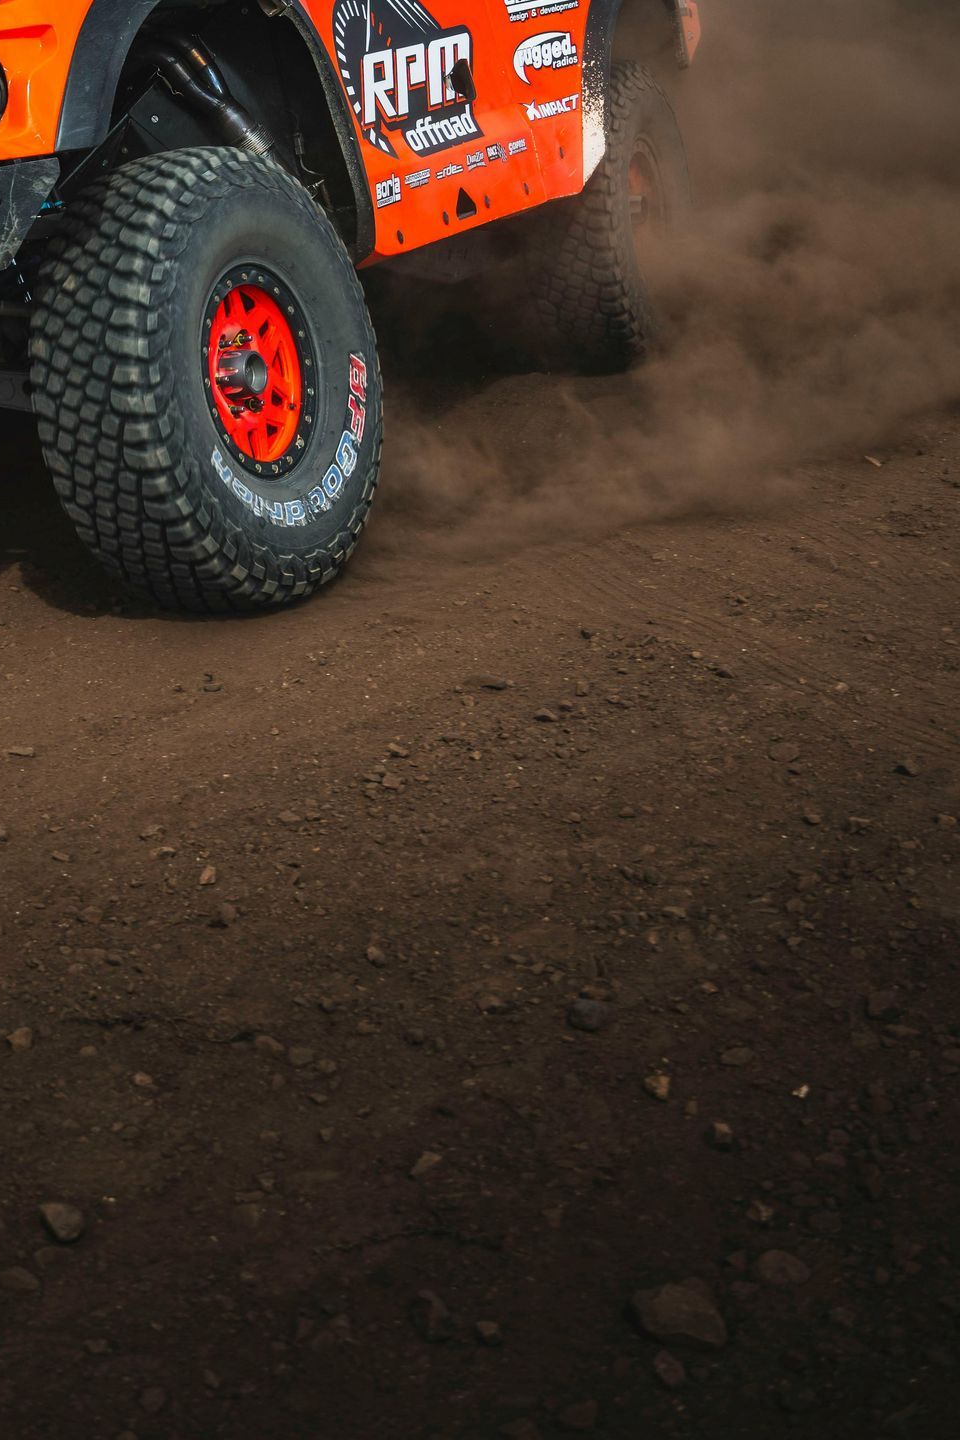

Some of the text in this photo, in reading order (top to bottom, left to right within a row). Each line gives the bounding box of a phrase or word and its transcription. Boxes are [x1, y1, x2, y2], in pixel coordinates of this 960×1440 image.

[509, 0, 579, 22] design & development
[552, 55, 578, 69] radios
[362, 32, 471, 125] RPM
[537, 94, 580, 119] IMPACT
[405, 103, 478, 152] offroad
